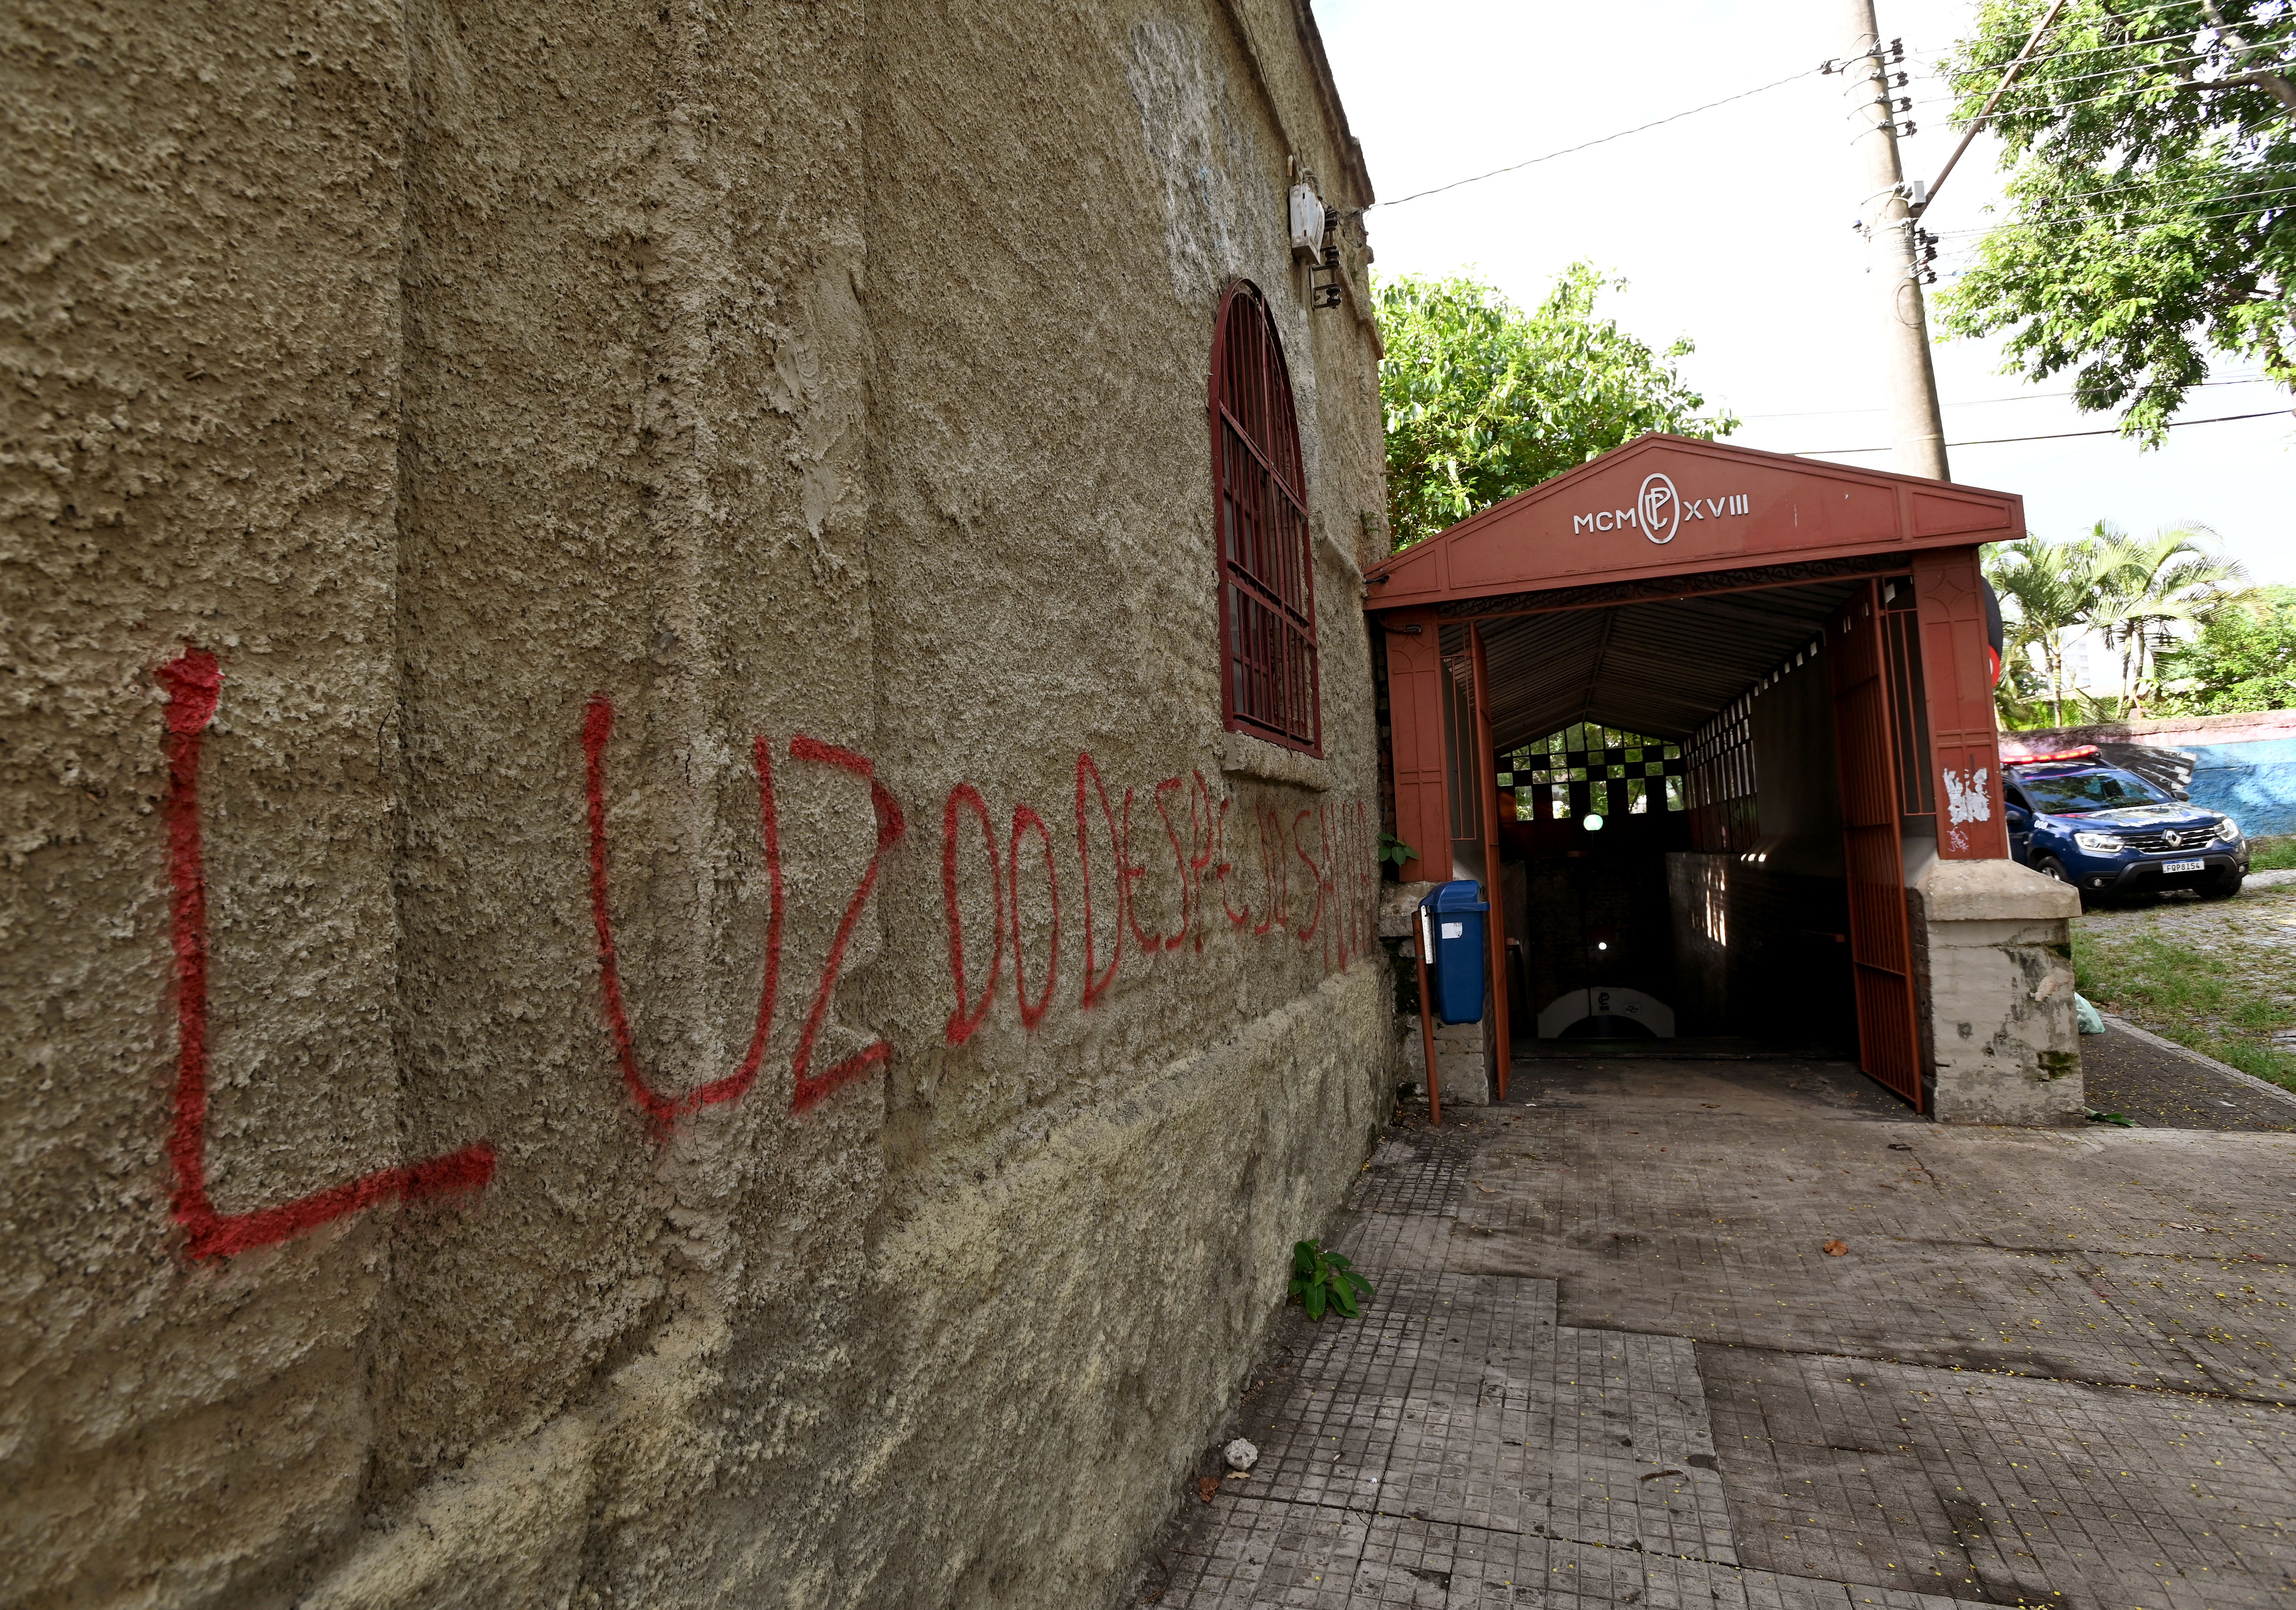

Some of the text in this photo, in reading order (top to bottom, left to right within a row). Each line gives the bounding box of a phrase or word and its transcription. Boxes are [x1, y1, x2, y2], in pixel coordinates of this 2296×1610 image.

[1573, 508, 1637, 535] MCM
[1683, 494, 1749, 521] XVIII
[2034, 820, 2049, 829] 008
[2166, 862, 2201, 872] FQP8I54
[156, 649, 906, 1262] LUZ
[943, 782, 1057, 1046] DO
